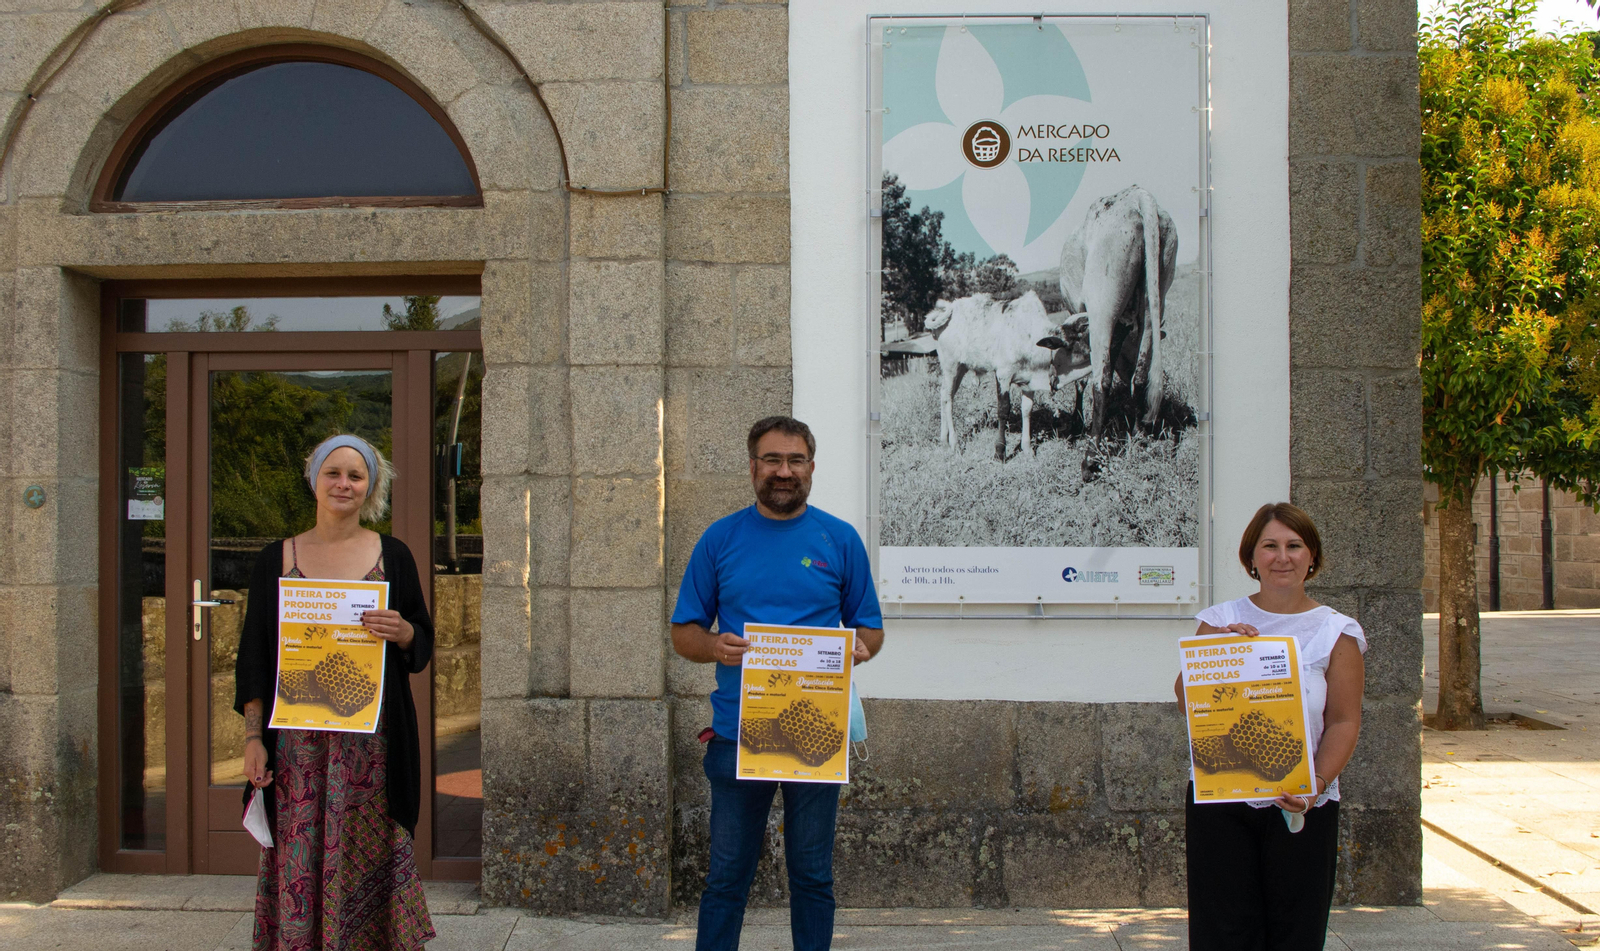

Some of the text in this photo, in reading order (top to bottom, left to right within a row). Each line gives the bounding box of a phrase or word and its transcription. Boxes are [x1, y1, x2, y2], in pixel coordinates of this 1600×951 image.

[1016, 124, 1110, 139] MERCADO
[1018, 148, 1121, 162] DA RESERVA
[967, 565, 999, 574] sábados
[1075, 571, 1118, 582] Allariz
[296, 590, 322, 598] FEIRA
[284, 601, 337, 610] PRODUTOS
[284, 609, 332, 620] APÍCOLAS
[331, 630, 368, 639] Degustación
[282, 636, 302, 645] Venda
[761, 636, 788, 644] FEIRA
[792, 637, 813, 645] DOS
[748, 646, 803, 656] PRODUTOS
[1198, 647, 1227, 657] FEIRA
[1230, 645, 1253, 654] DOS
[748, 655, 797, 667] APÍCOLAS
[1186, 658, 1245, 670] PRODUTOS
[1188, 670, 1240, 682] APÍCOLAS
[796, 677, 834, 687] Degustación
[744, 684, 765, 692] Venda
[1242, 686, 1283, 699] Degustación
[1189, 702, 1211, 712] Venda
